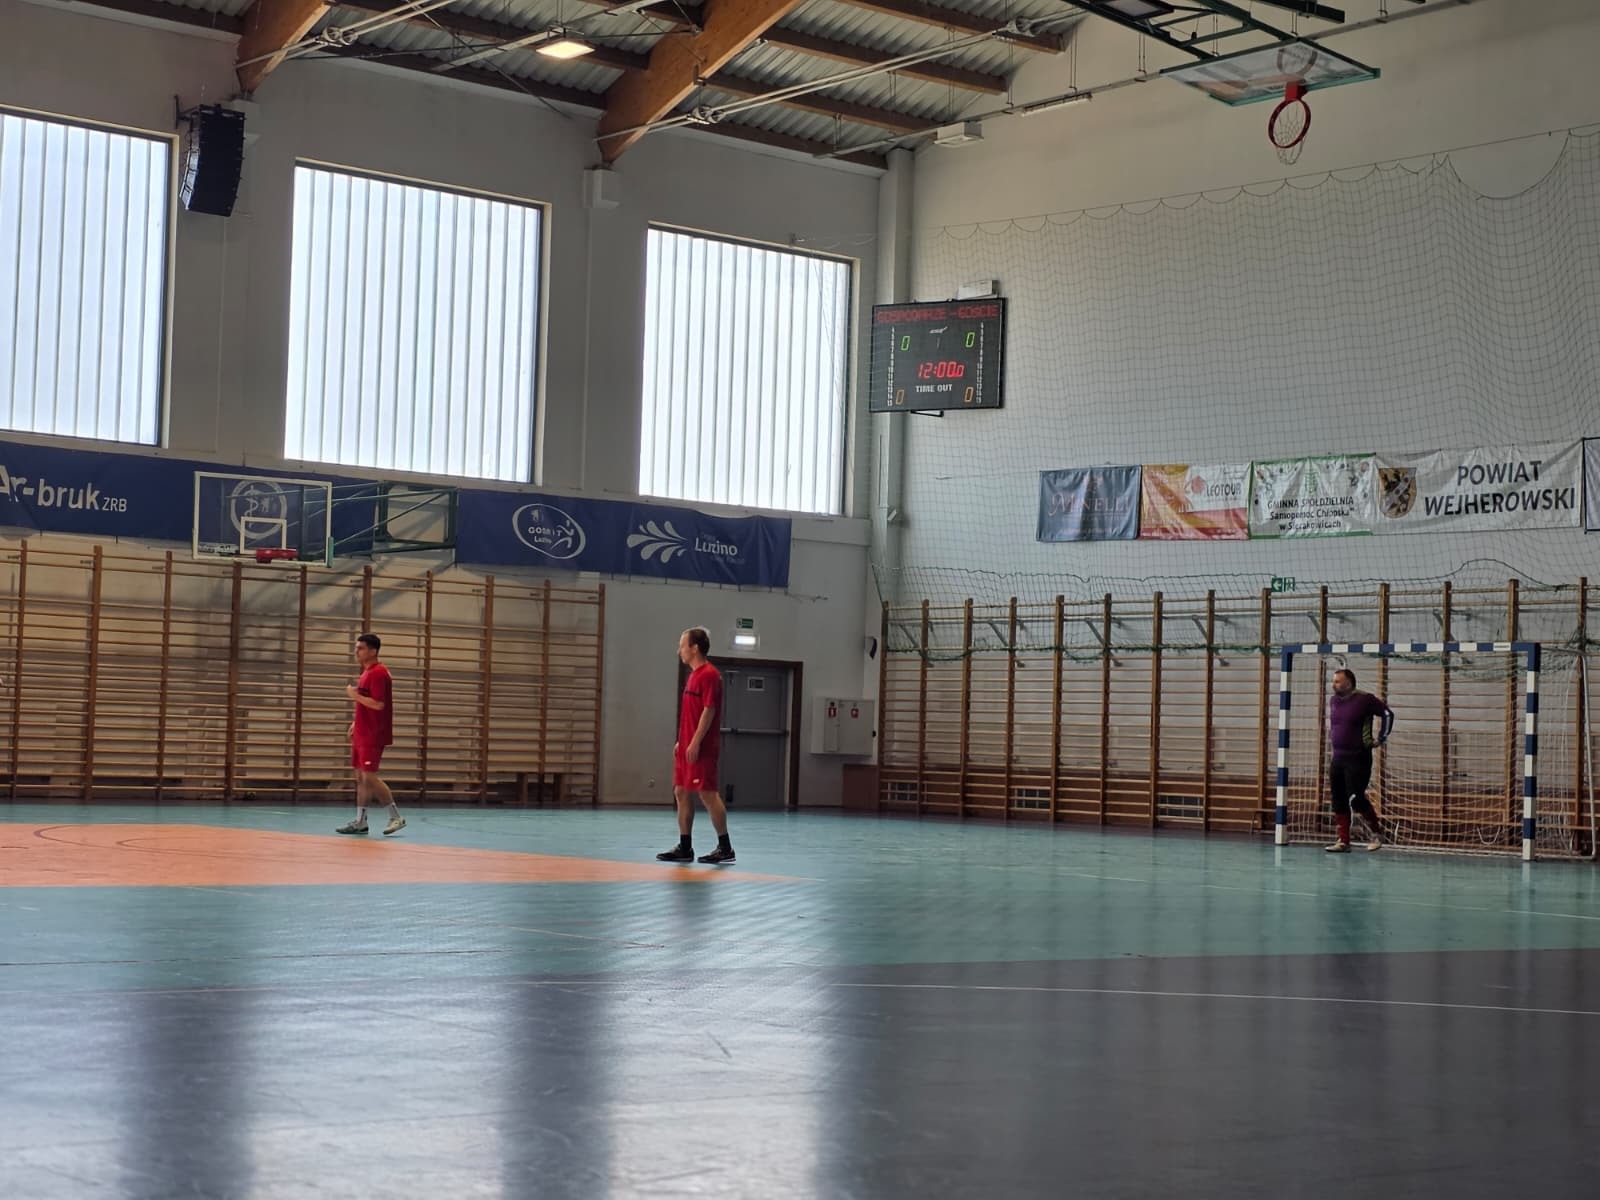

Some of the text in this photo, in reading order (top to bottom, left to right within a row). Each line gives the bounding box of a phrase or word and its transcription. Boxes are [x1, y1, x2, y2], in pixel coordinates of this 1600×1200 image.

[901, 335, 910, 351] 0
[965, 332, 975, 347] 0
[915, 383, 952, 393] TIME OUT
[965, 387, 974, 402] 0
[896, 390, 904, 405] 0
[1457, 461, 1543, 486] POWIAT
[102, 497, 127, 512] ZRB
[1424, 488, 1576, 516] WEJHEROWSKI
[695, 537, 738, 556] Luzino
